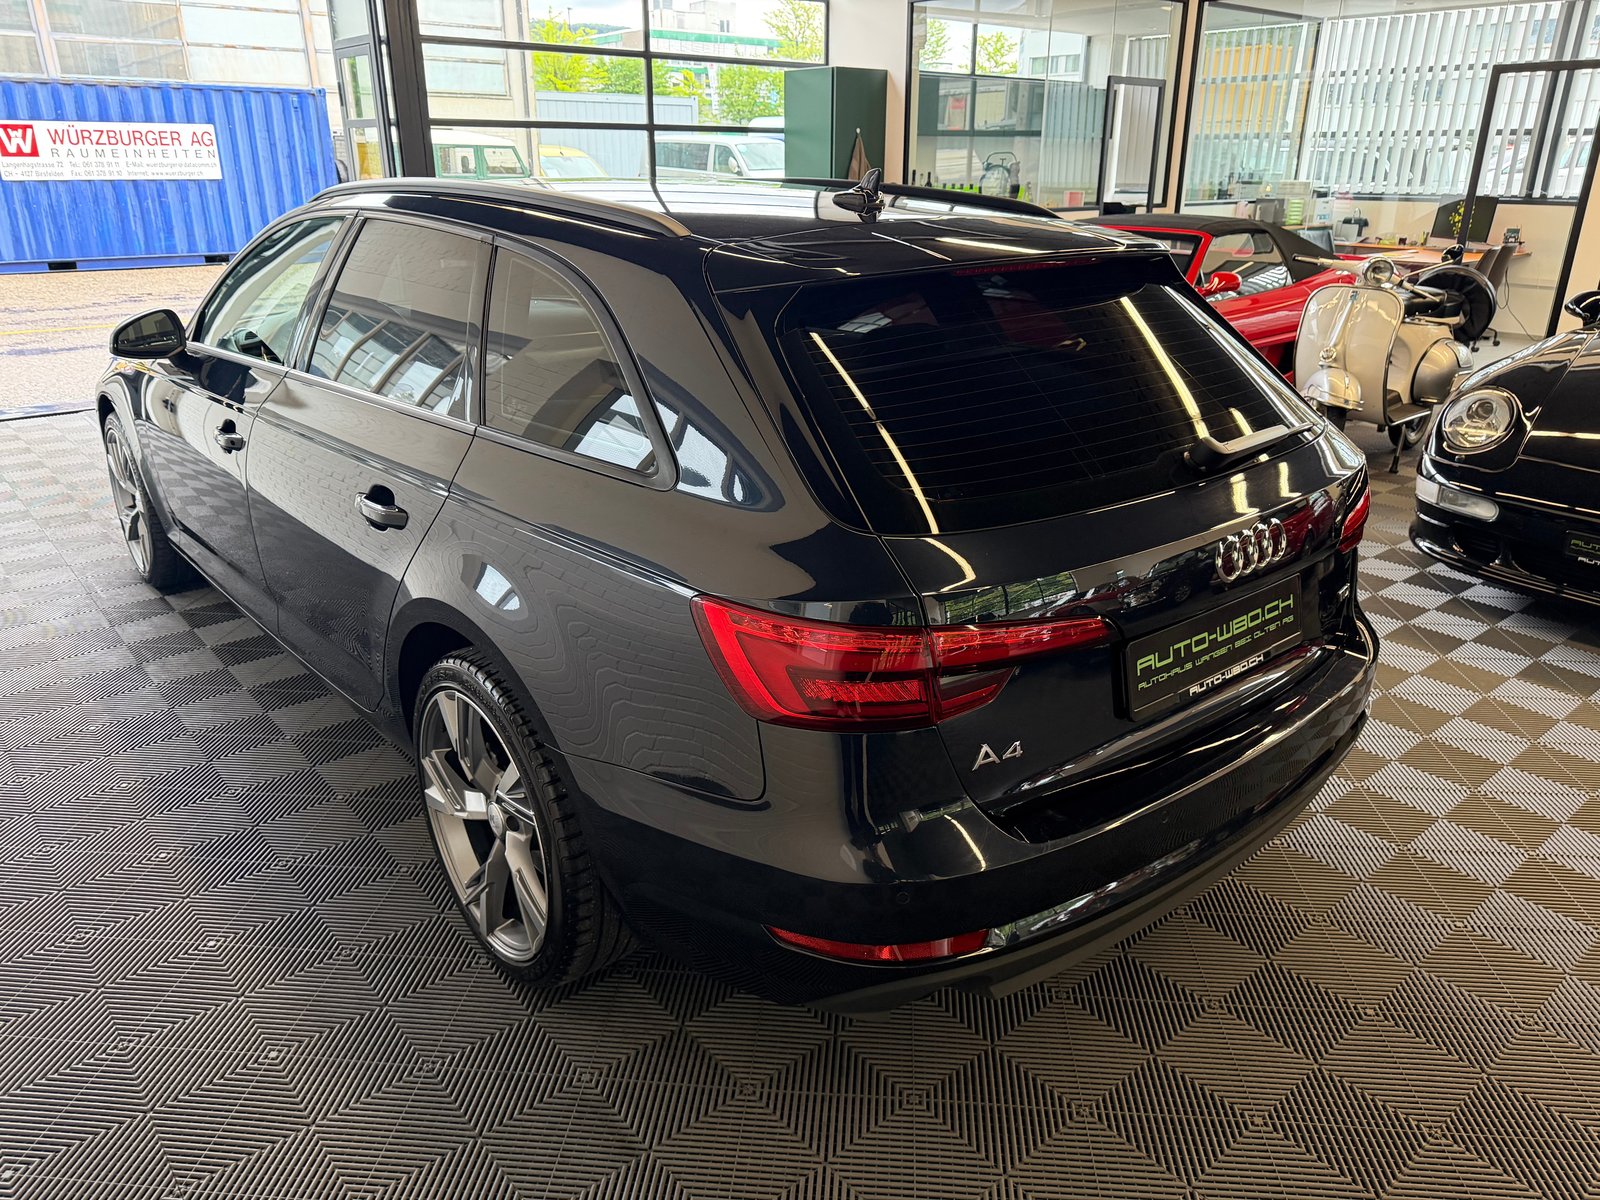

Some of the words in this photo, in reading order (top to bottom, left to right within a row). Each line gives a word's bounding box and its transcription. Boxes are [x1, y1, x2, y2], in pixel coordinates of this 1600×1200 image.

[47, 124, 182, 146] WÜRZBURGER
[190, 131, 214, 147] AG
[50, 148, 216, 159] RAUMEINHEITEN
[1137, 593, 1294, 677] AUTO-WBO.CH
[1138, 661, 1193, 691] AUTOHAUS
[1195, 644, 1233, 666] WANGEN
[1234, 634, 1252, 649] BEI
[1253, 620, 1281, 639] OLTEN
[1282, 614, 1294, 626] AG
[1189, 653, 1264, 697] AUTO-WBO.CH
[971, 740, 1024, 771] A4
